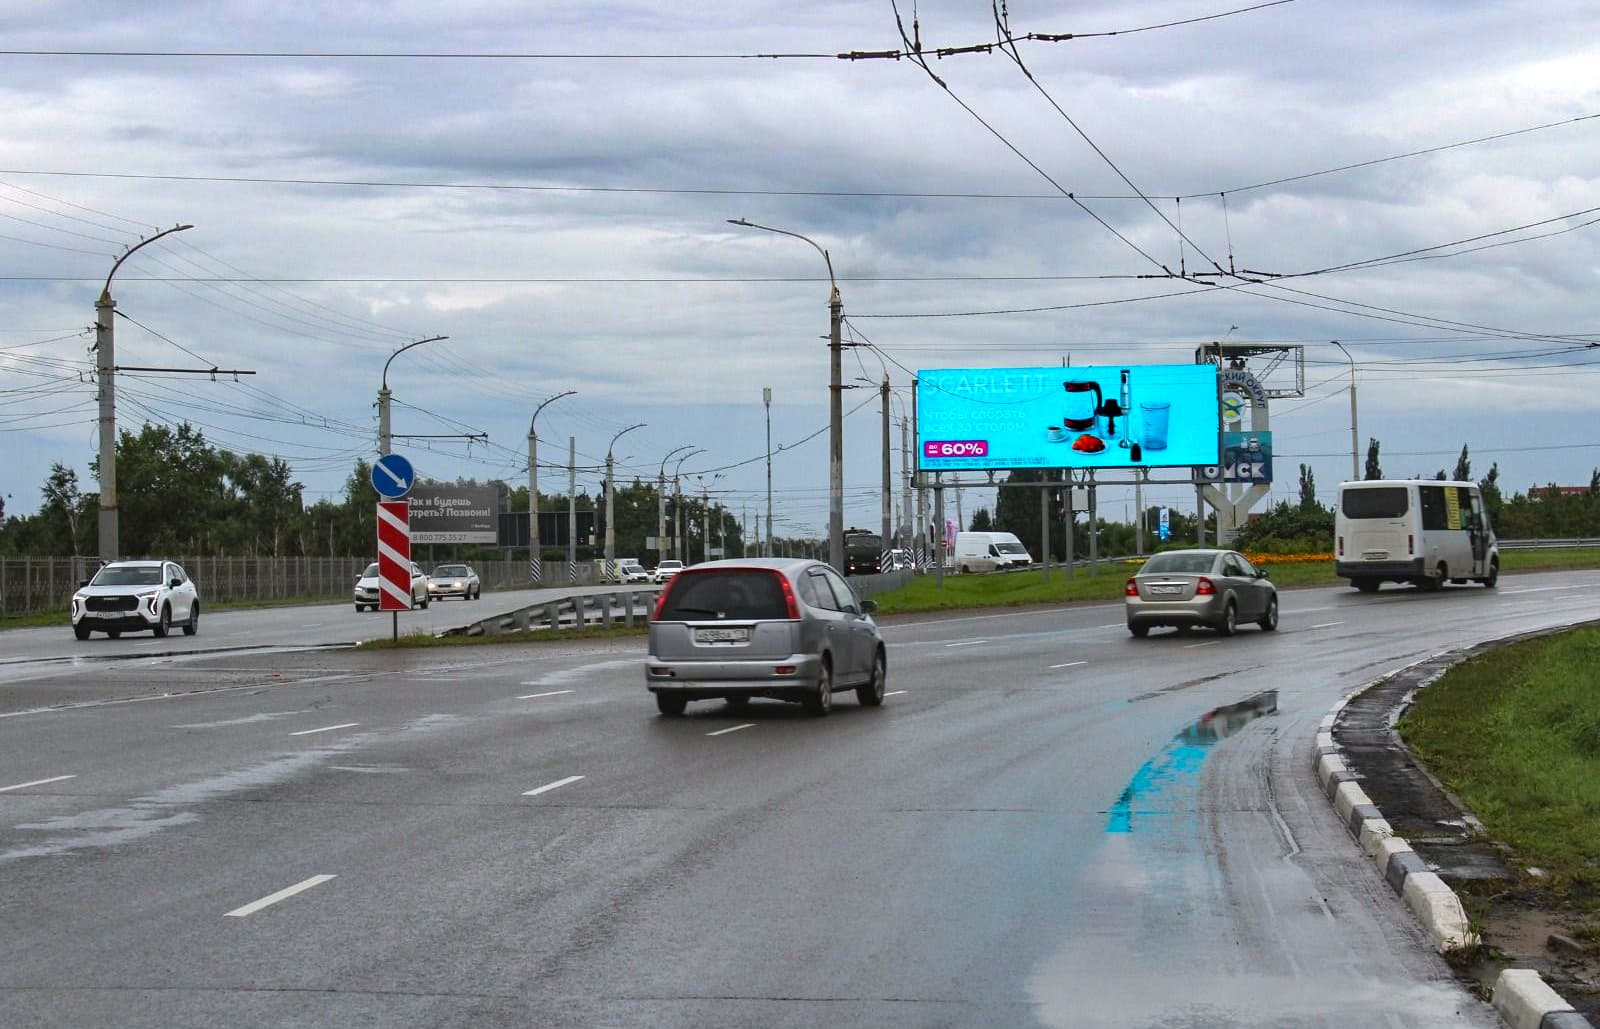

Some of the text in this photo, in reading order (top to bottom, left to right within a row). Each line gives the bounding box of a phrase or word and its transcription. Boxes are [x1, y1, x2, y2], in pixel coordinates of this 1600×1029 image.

[1223, 373, 1246, 383] КИЙ
[921, 374, 1049, 395] SCARLETT
[923, 407, 1026, 421] Чтобы собрать
[923, 421, 1025, 433] всех за столом
[1204, 462, 1264, 478] ОМСК
[407, 497, 424, 506] Так
[434, 496, 471, 508] будешь
[446, 507, 491, 517] Позвони!
